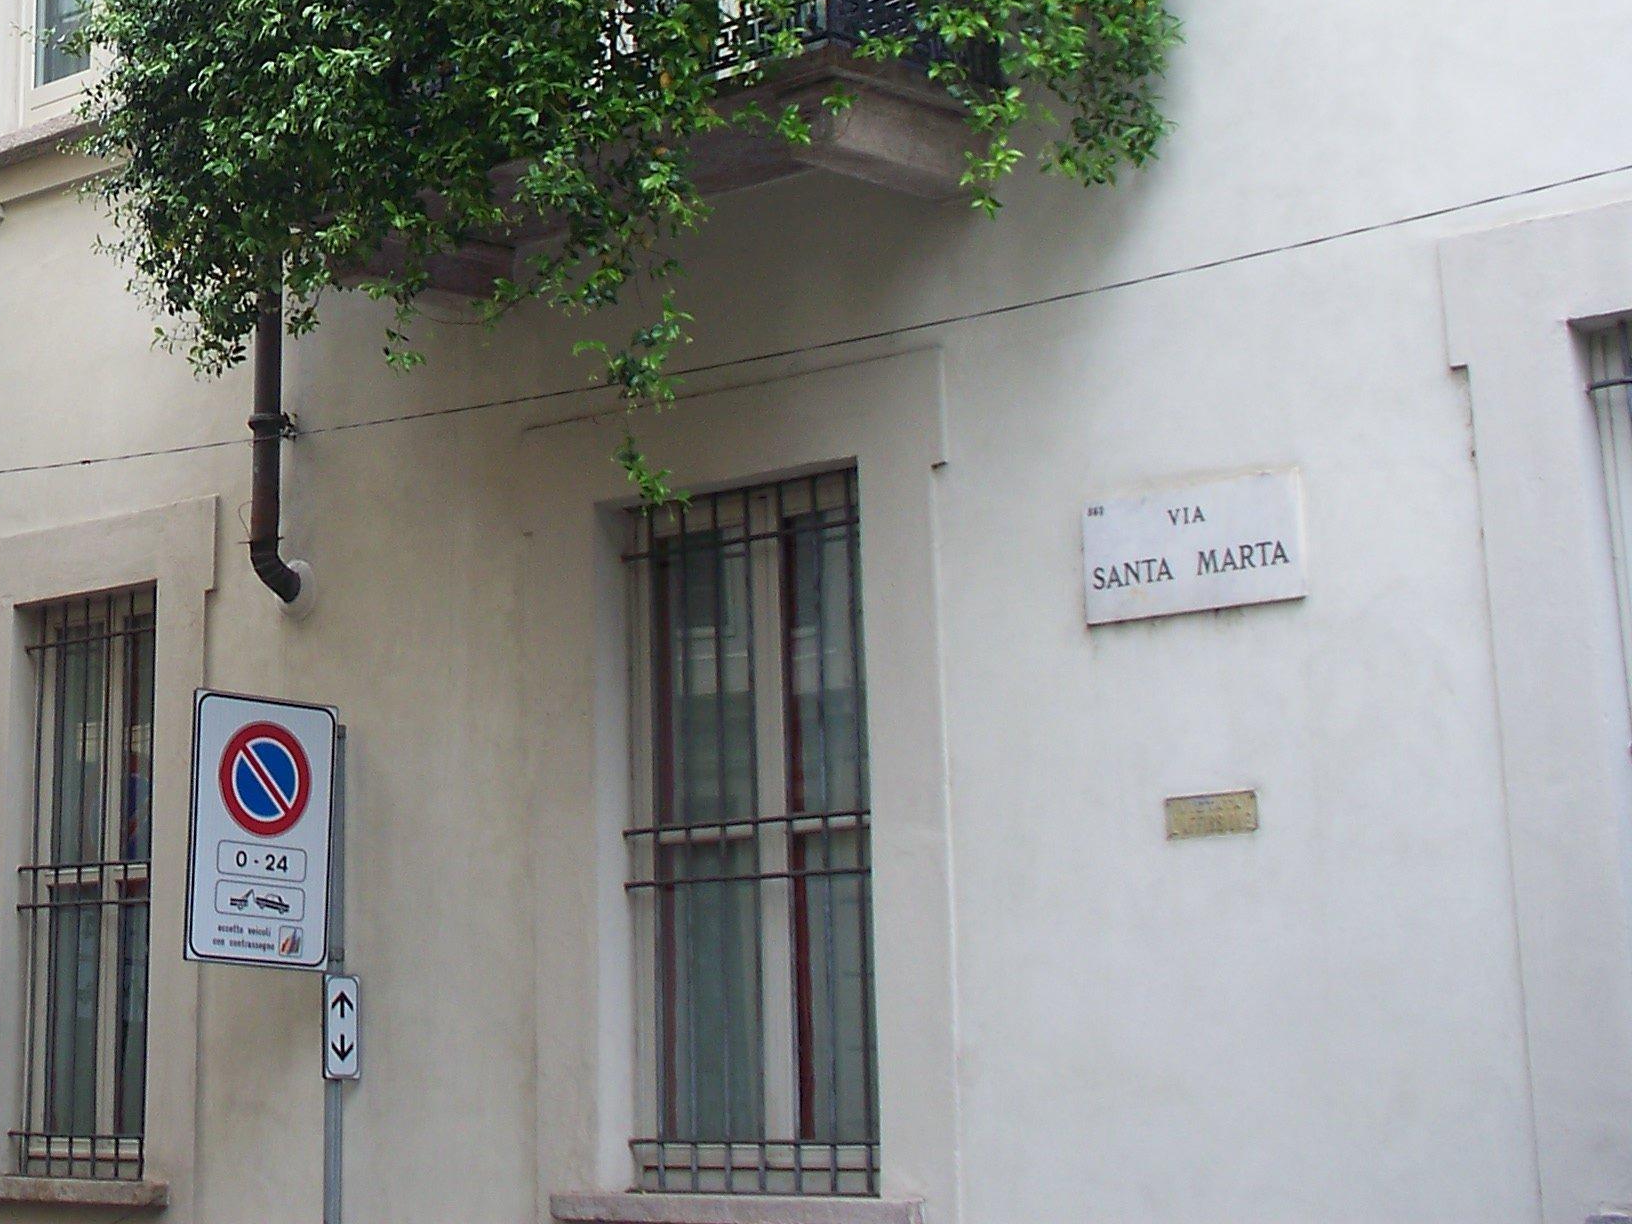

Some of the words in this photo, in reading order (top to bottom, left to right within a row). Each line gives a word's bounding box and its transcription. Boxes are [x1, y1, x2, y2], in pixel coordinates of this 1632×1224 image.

[1167, 506, 1206, 526] VIA
[1092, 557, 1174, 591] SANTA
[1197, 540, 1290, 576] MARTA
[236, 850, 247, 868] 0
[265, 854, 288, 873] 24
